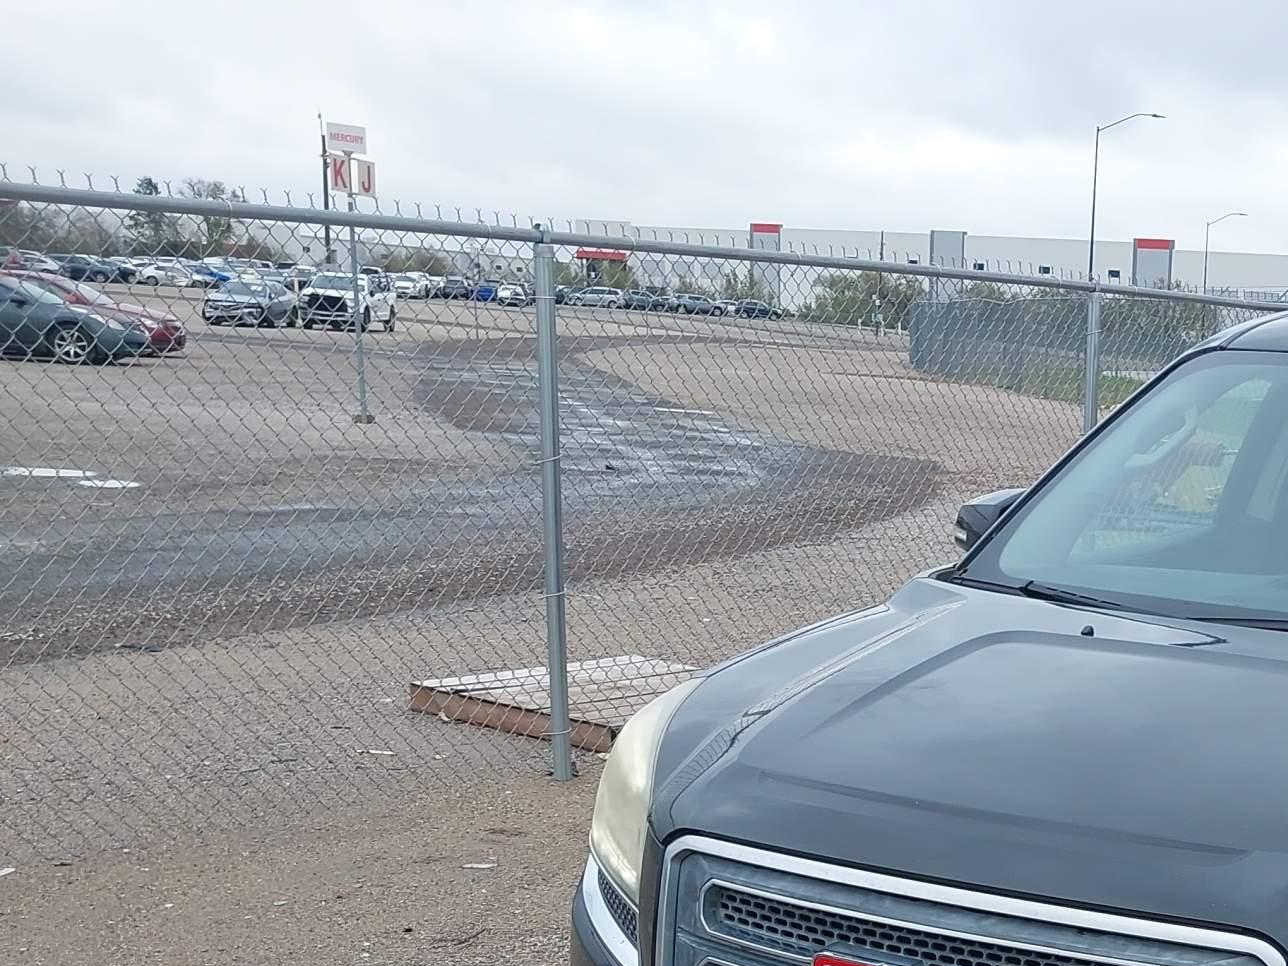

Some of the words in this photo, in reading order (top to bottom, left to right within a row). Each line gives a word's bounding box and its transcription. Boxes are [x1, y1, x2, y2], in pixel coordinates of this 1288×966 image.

[329, 132, 364, 144] MERCURY
[333, 158, 348, 189] K
[361, 165, 371, 193] J
